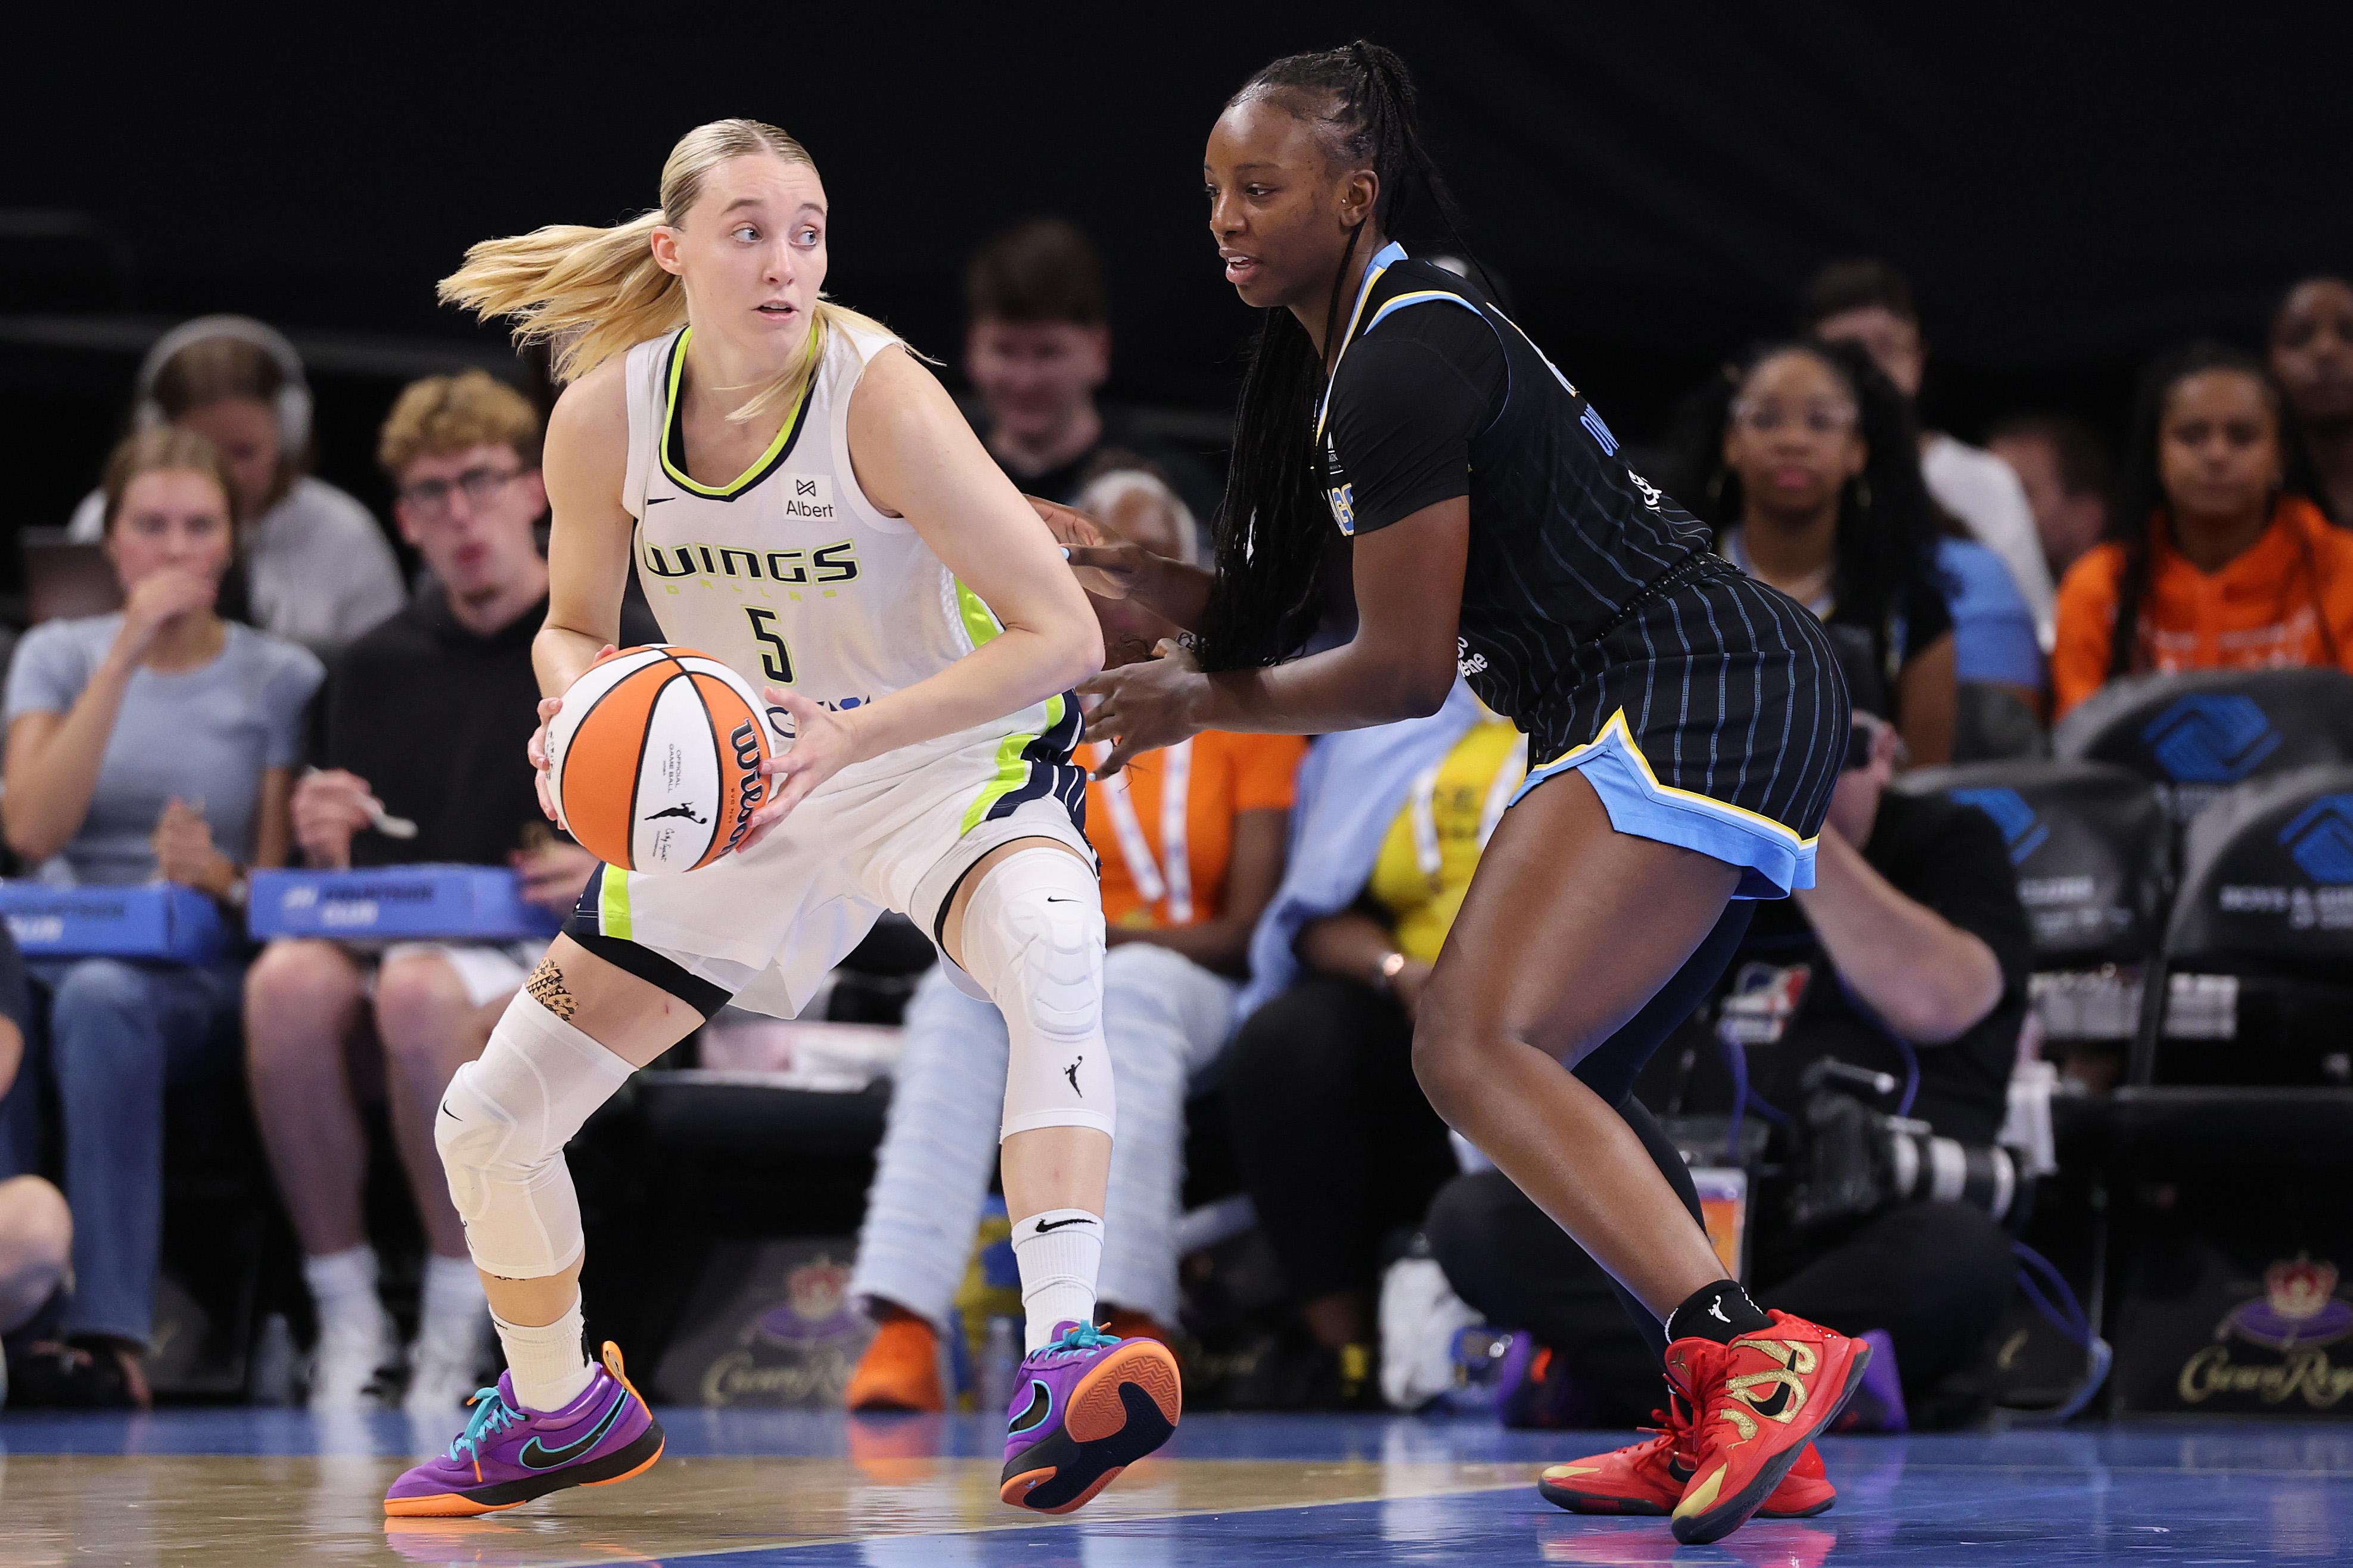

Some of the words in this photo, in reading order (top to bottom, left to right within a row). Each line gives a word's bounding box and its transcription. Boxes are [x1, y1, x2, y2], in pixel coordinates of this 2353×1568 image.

[786, 499, 834, 518] Albert
[645, 539, 862, 586] WINGS
[665, 578, 837, 602] DALLAS
[741, 603, 798, 686] 5
